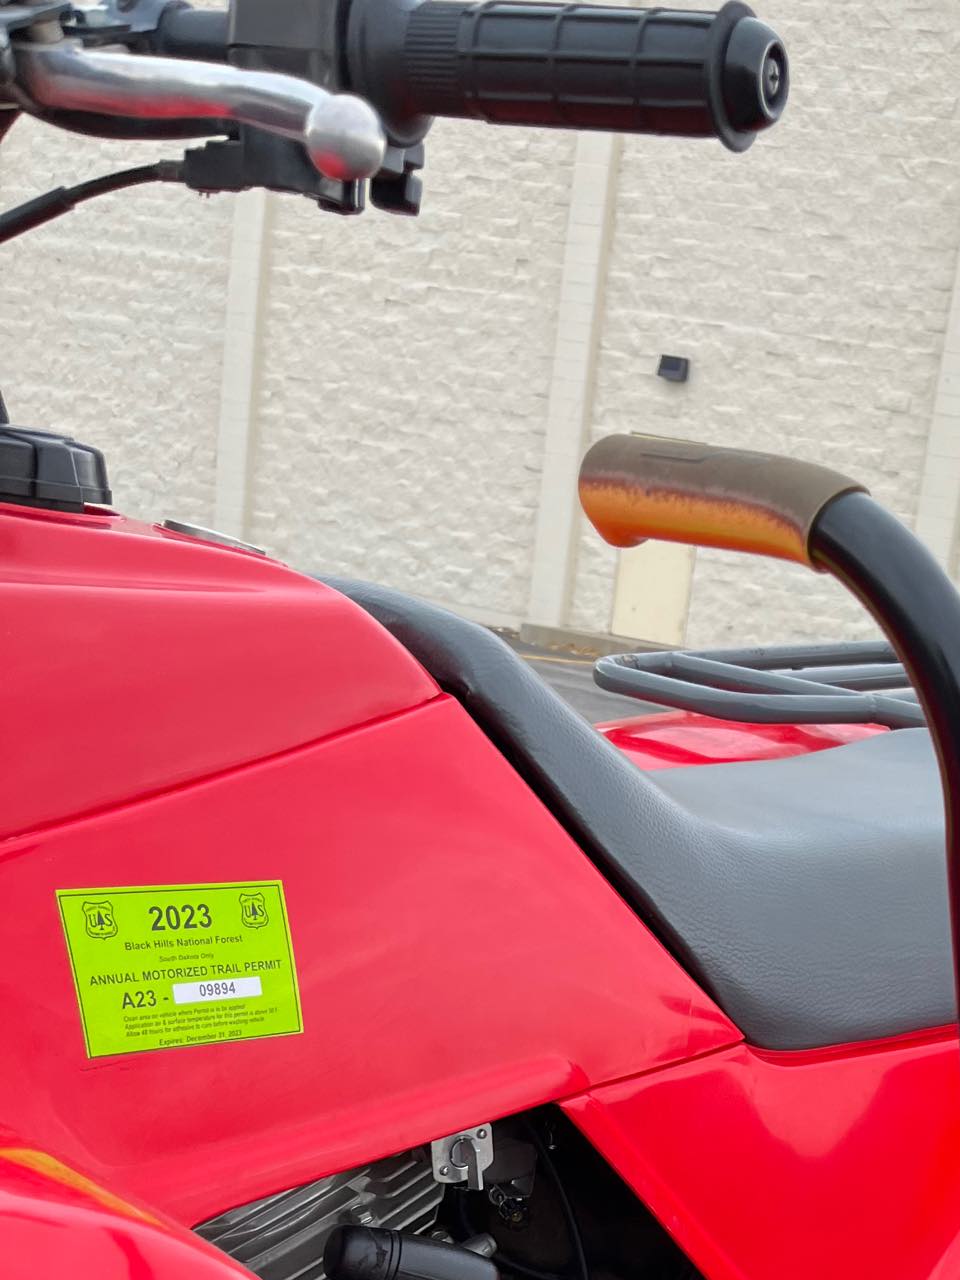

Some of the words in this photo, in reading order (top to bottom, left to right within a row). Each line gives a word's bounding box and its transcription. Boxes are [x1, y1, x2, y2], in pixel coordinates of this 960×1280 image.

[148, 904, 212, 931] 2023
[124, 941, 151, 950] Black
[154, 939, 174, 948] Hills
[176, 937, 212, 946] National
[215, 934, 242, 943] Forest
[89, 972, 138, 986] ANNUAL
[142, 966, 207, 981] MOTORIZED
[210, 963, 241, 974] TRAIL
[244, 960, 281, 971] PERMIT
[120, 990, 156, 1009] A23
[199, 982, 236, 996] 09894
[186, 1033, 216, 1041] December
